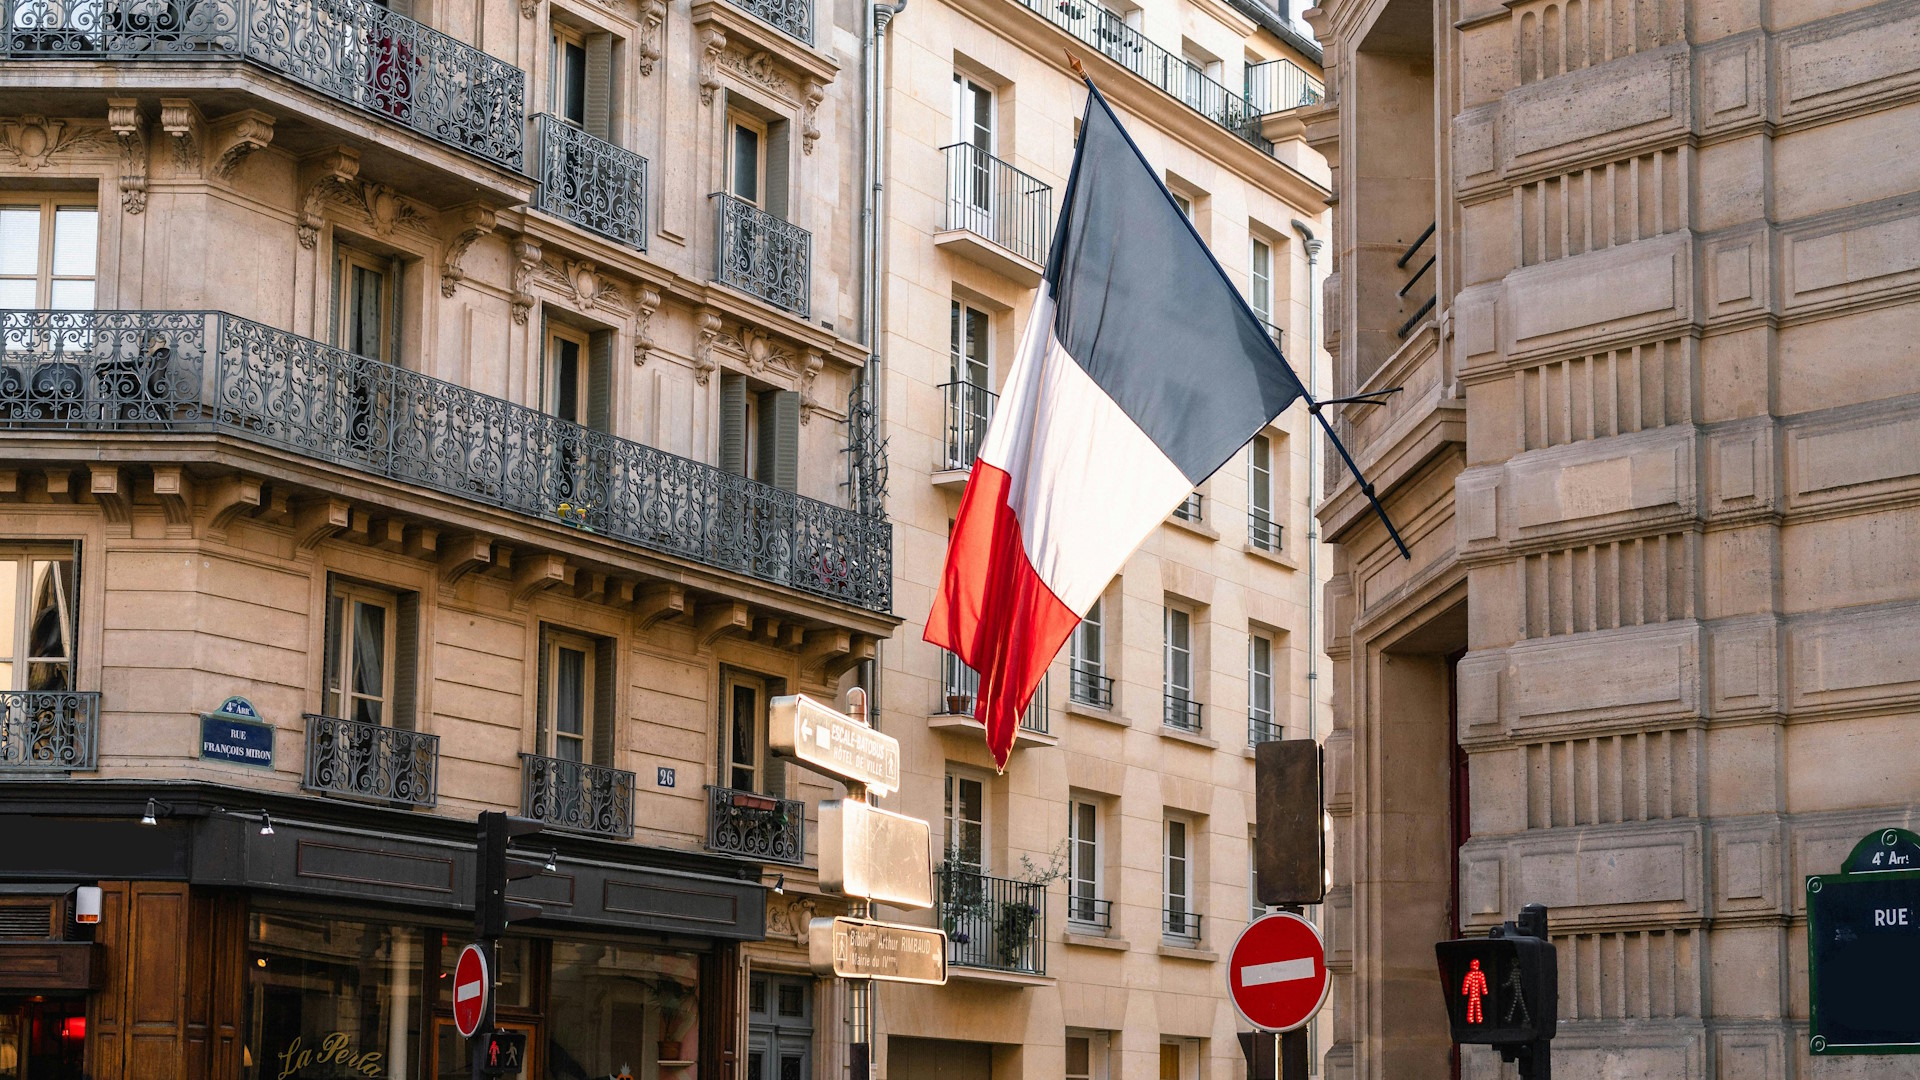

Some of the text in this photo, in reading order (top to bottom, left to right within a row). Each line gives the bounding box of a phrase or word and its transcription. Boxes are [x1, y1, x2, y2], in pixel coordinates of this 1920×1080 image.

[230, 729, 247, 740] RUE
[203, 742, 272, 760] FRANÇOIS MIRON
[833, 745, 884, 777] HÔTEL DE VILLE
[660, 769, 673, 785] 26
[1874, 907, 1909, 927] RUE
[877, 934, 899, 950] Arthur
[900, 937, 931, 955] RIMBAUD
[850, 952, 870, 967] Mairie
[872, 955, 880, 968] du
[277, 1031, 382, 1080] La Perla
